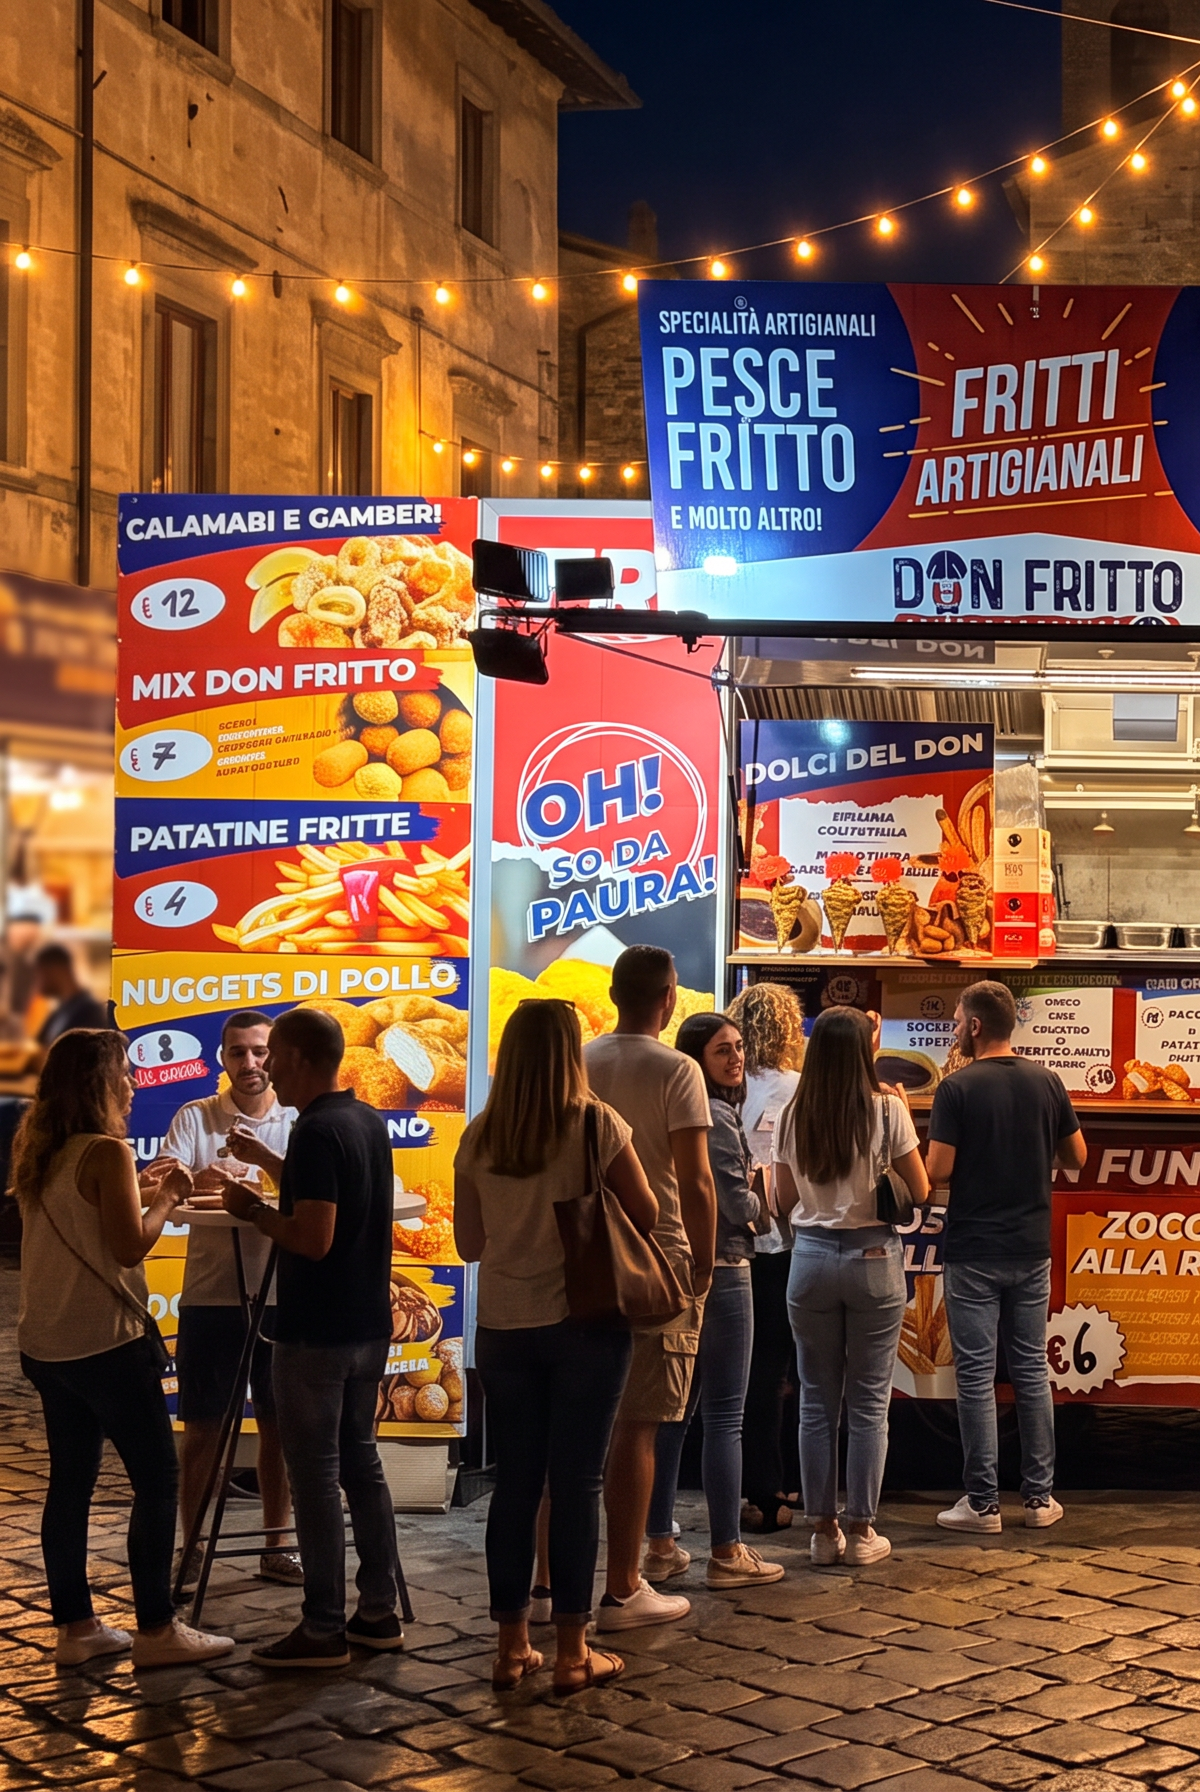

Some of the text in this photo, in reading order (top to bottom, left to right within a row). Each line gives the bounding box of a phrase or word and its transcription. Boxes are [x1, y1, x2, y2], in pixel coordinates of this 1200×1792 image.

[659, 307, 876, 337] SPECIALITÀ ARTIGIANALI
[661, 346, 838, 418] PESCE
[951, 349, 1120, 439] FRITTI
[666, 421, 856, 493] FRITTO
[915, 434, 1144, 506] ARTIGIANALI
[284, 509, 301, 531] E
[671, 507, 822, 531] E MOLTO ALTRO!
[161, 588, 200, 618] 12
[1024, 559, 1183, 614] FRITTO
[132, 658, 416, 701] MIX DON FRITTO
[152, 742, 176, 770] 7
[745, 732, 983, 785] DOLCI DEL DON
[523, 753, 664, 842] OH!
[130, 812, 411, 852] PATATINE FRITTE
[549, 830, 671, 888] SO DA
[164, 886, 186, 916] 4
[528, 855, 717, 942] PAURA!
[121, 963, 457, 1007] NUGGETS DI POLLO
[158, 1034, 174, 1062] 8
[1071, 1248, 1168, 1277] ALLA
